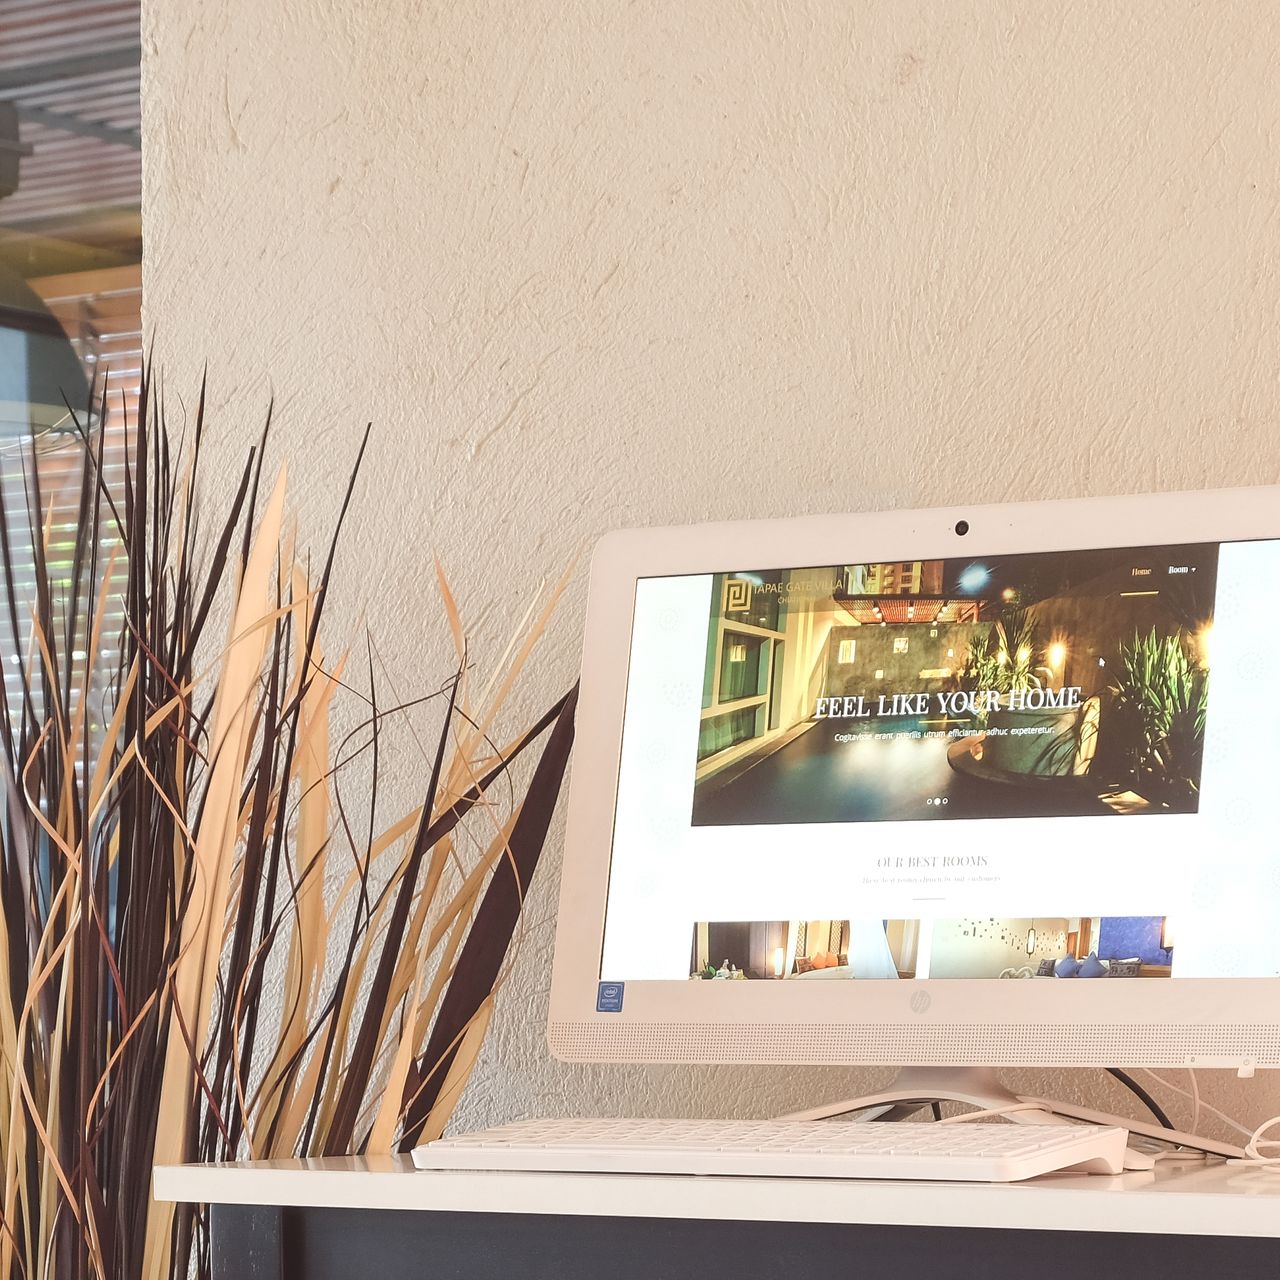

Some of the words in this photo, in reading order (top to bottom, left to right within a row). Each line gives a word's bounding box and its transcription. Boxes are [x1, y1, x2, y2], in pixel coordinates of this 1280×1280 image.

[1168, 565, 1189, 574] Room
[753, 582, 783, 595] TAPAE
[785, 581, 812, 592] GATE
[813, 696, 871, 719] FEEL
[876, 692, 930, 716] LIKE
[936, 689, 1002, 714] YOUR
[1007, 685, 1084, 711] HOME
[985, 727, 1009, 737] adhuc
[942, 855, 989, 867] ROOMS
